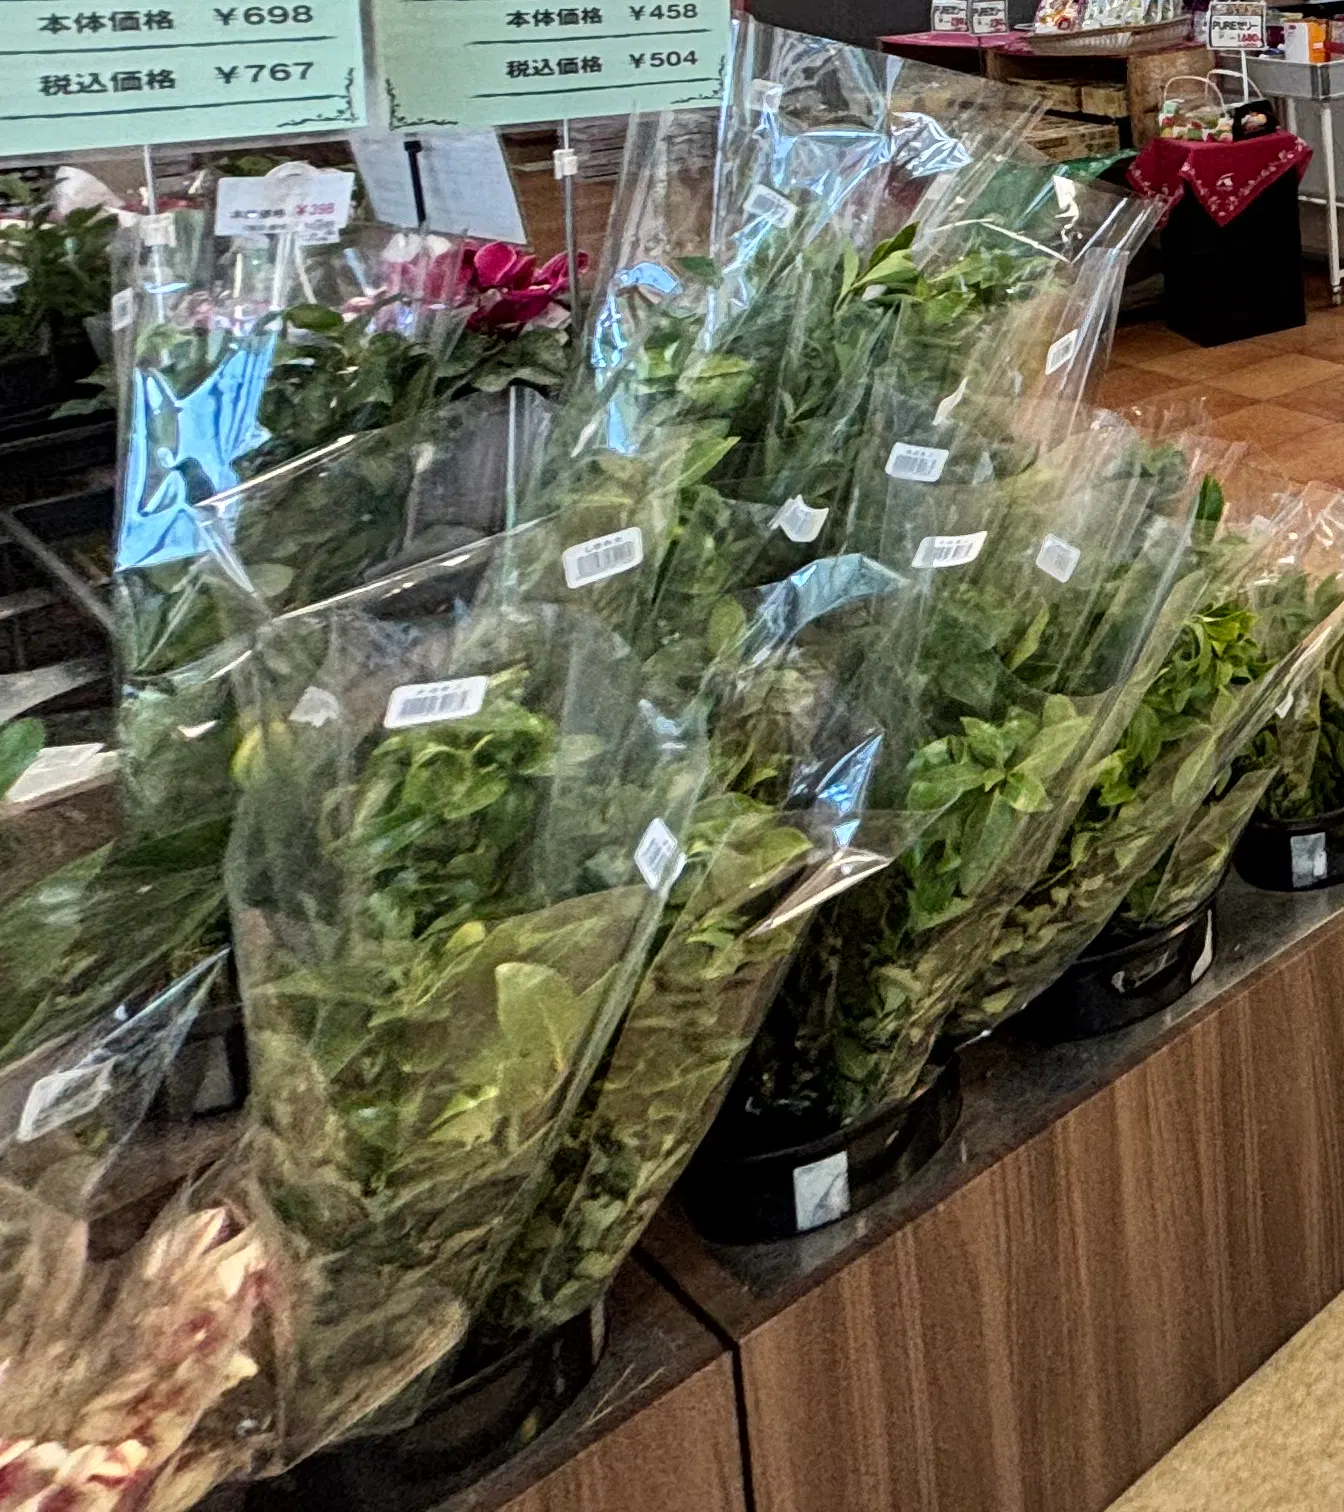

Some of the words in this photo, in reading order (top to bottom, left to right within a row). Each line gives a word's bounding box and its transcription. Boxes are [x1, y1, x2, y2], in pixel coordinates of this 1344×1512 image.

[38, 9, 176, 35] 本体価格
[213, 4, 316, 27] ¥698
[505, 6, 604, 29] 本体価格
[628, 2, 699, 22] ¥458
[39, 69, 178, 97] 税込価格
[214, 61, 316, 86] ¥767
[505, 56, 604, 80] 税込価格
[628, 50, 699, 70] ¥504
